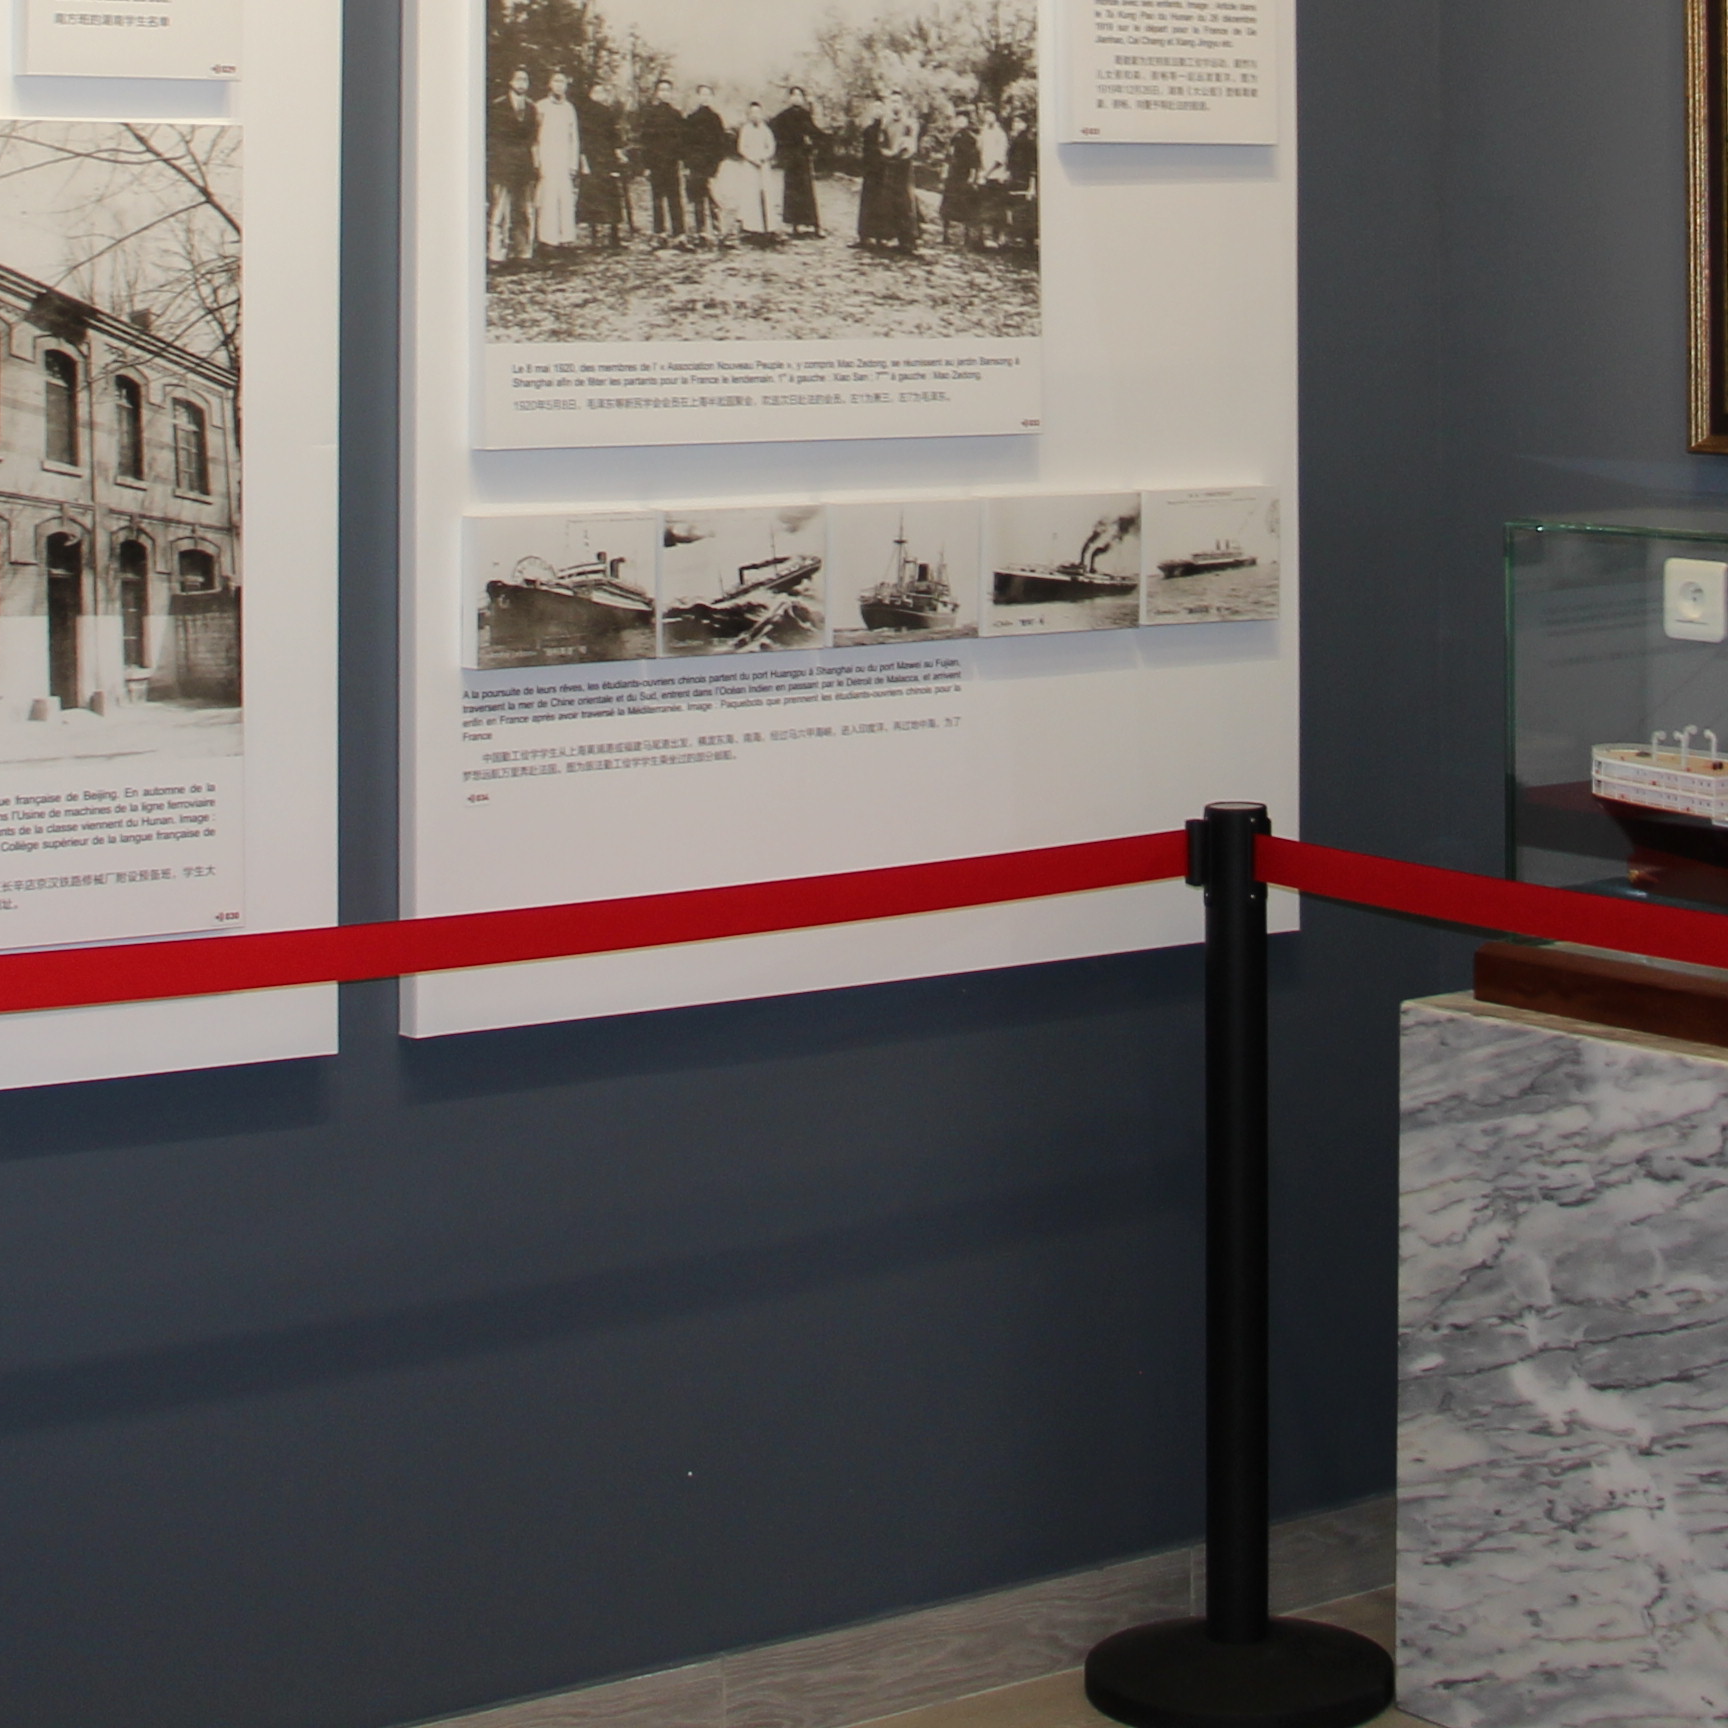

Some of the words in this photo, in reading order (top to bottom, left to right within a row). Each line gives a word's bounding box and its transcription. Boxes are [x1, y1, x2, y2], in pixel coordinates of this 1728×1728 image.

[15, 792, 62, 808] française
[66, 790, 80, 802] de
[124, 786, 139, 798] En
[143, 784, 187, 798] automne
[190, 782, 203, 794] de
[206, 782, 217, 794] la
[19, 824, 32, 836] de
[34, 824, 45, 834] la
[46, 822, 79, 834] classe
[81, 818, 124, 832] viennent
[126, 818, 139, 828] du
[179, 812, 211, 828] Image
